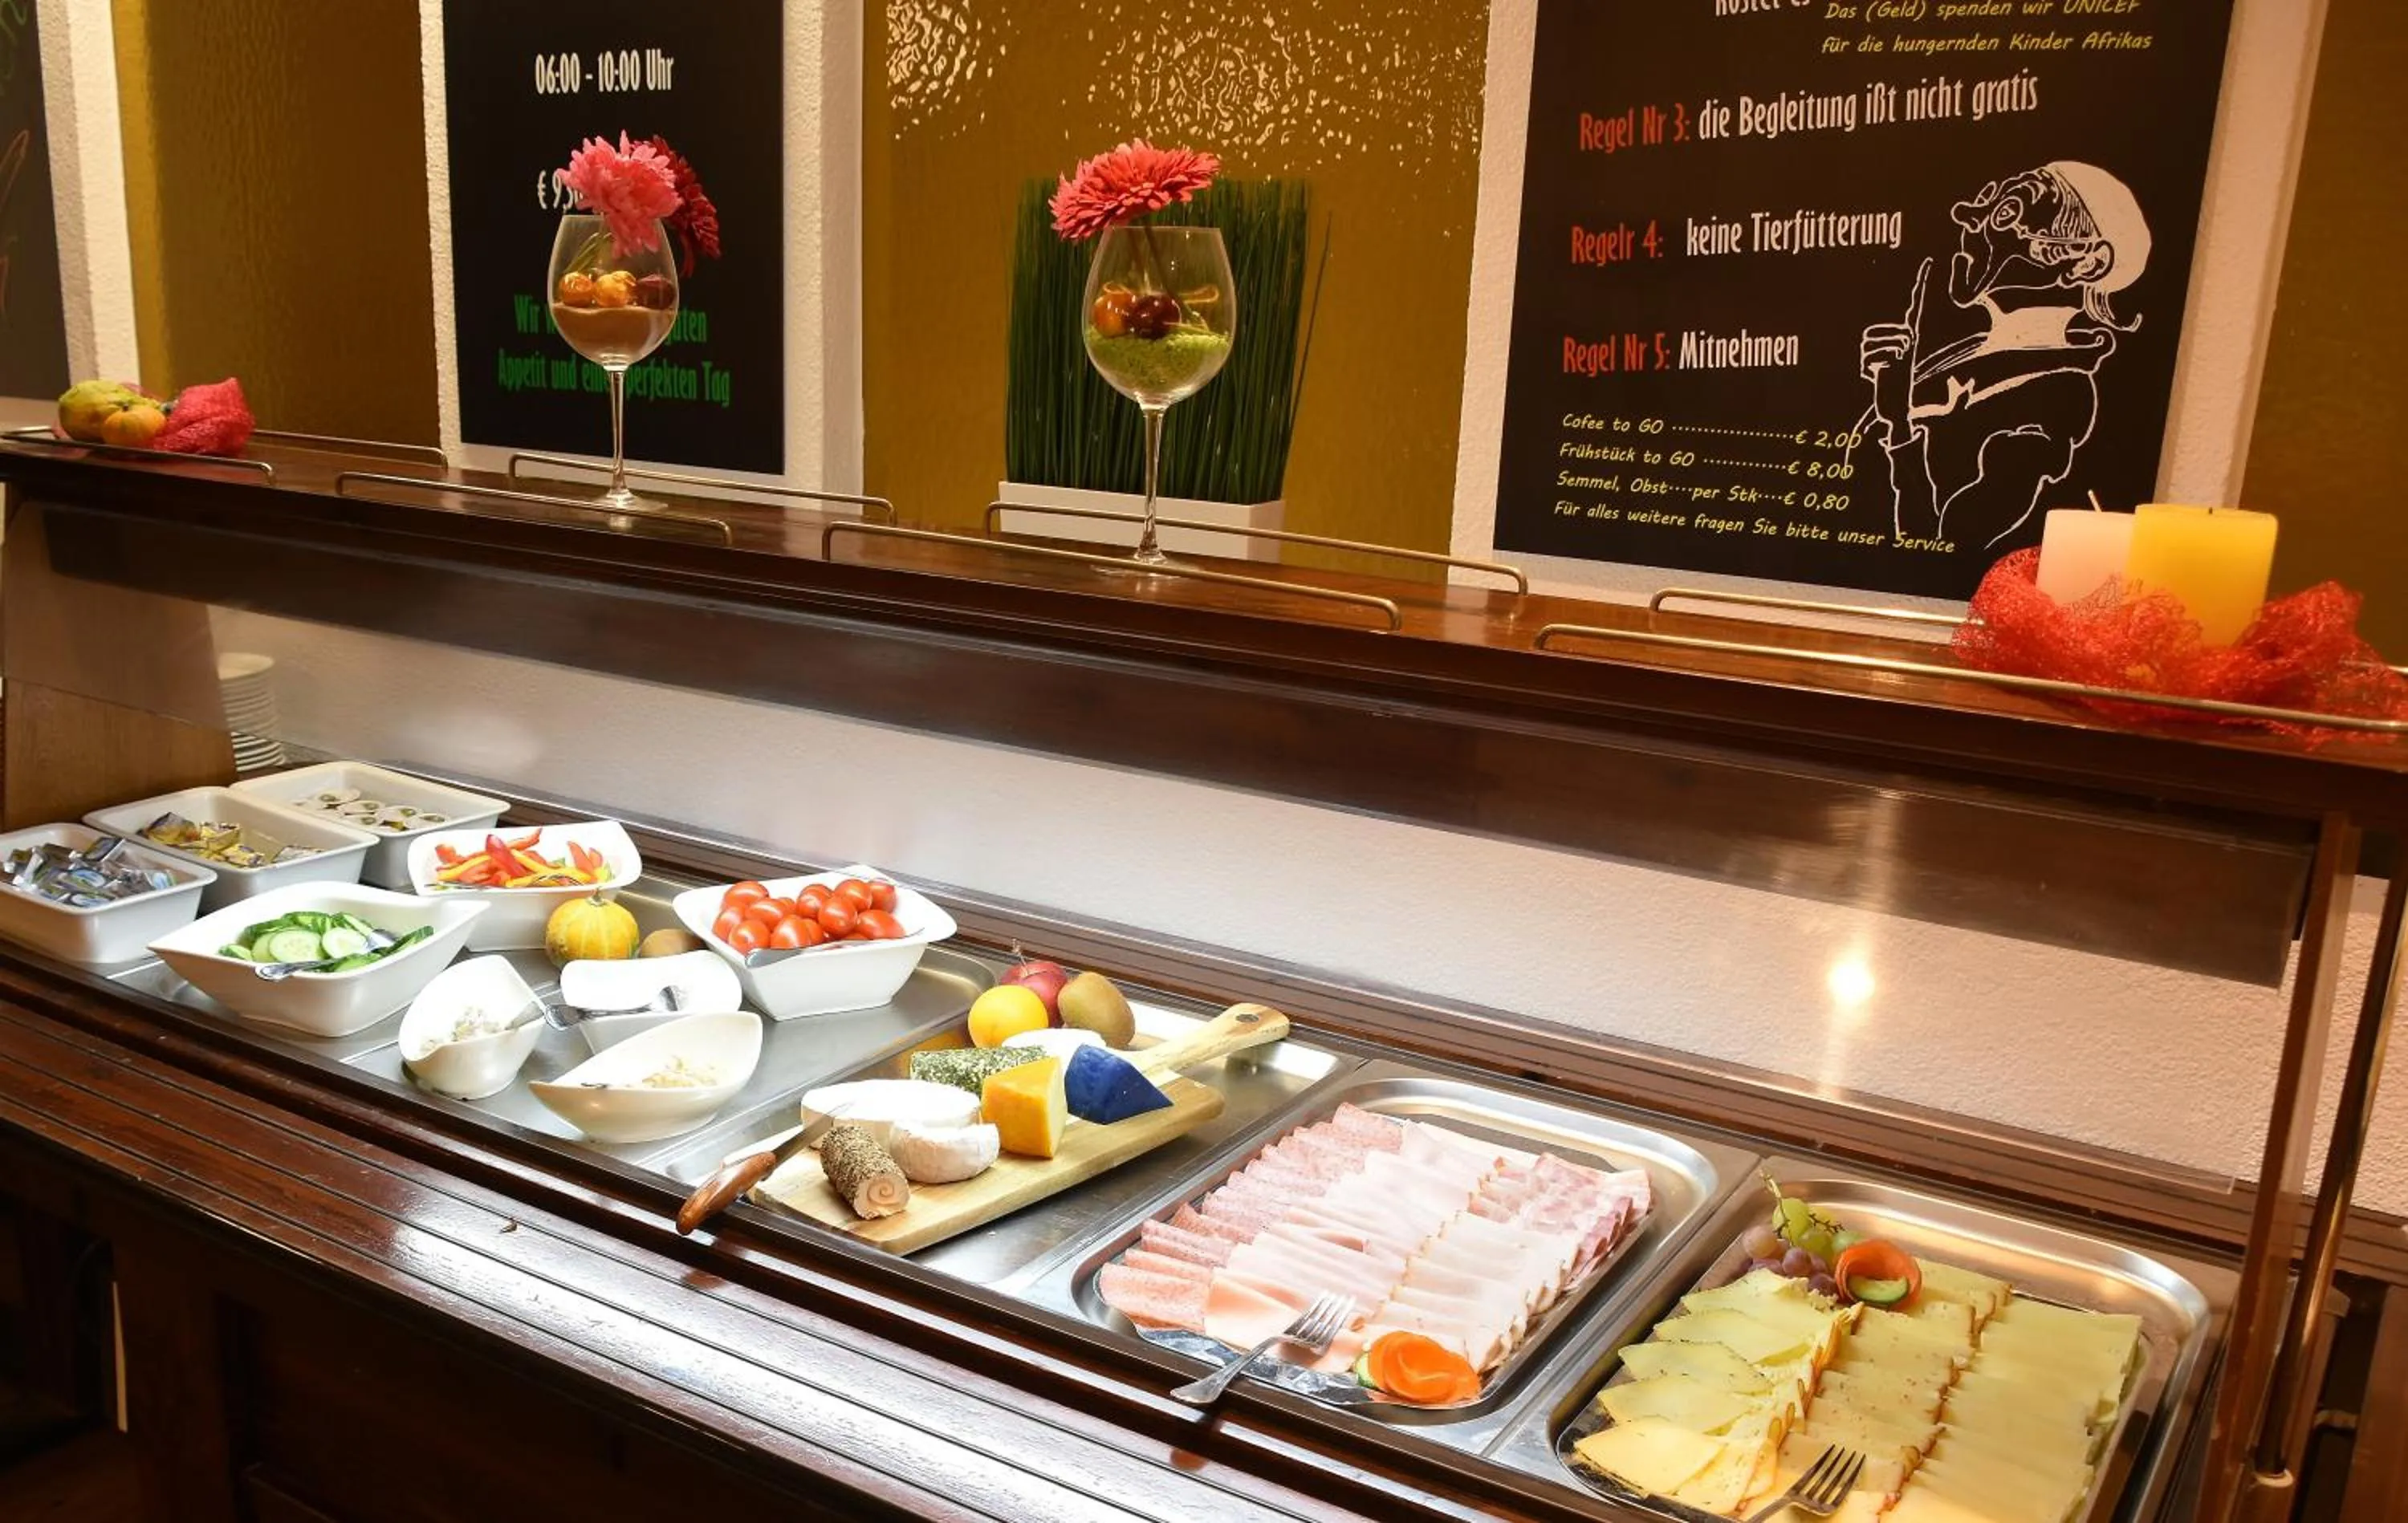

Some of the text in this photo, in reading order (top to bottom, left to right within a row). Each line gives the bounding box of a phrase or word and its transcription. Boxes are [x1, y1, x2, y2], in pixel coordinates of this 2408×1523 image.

[1824, 2, 1857, 18] Das
[1866, 0, 1926, 22] (Geld)
[1936, 0, 2011, 20] spenden
[2023, 0, 2052, 14] wir
[2064, 0, 2141, 14] UNICEF
[1822, 30, 2153, 56] für die hungernden Kinder Afrikas
[535, 53, 580, 95] 06:00
[598, 49, 641, 92] 10:00
[645, 48, 673, 91] Uhr
[1580, 67, 2038, 153] Regel Nr 3: die Begleitung ißt nicht gratis
[537, 169, 547, 209] €
[1571, 209, 1902, 267] Regelr 4: keine Tierfütterung
[514, 294, 541, 334] Wir
[1563, 329, 1799, 377] Regel Nr 5: Mitnehmen
[551, 353, 577, 391] und
[701, 361, 730, 408] Tag
[1562, 413, 1862, 449] Cofee to GO € 2,00
[1560, 443, 1854, 480] Frühstück to GO € 8,00
[1556, 470, 1620, 493] Semmel,
[1804, 492, 1849, 510] 0,80
[1554, 501, 1955, 553] Für alles weitere fragen Sie bitte unser Service
